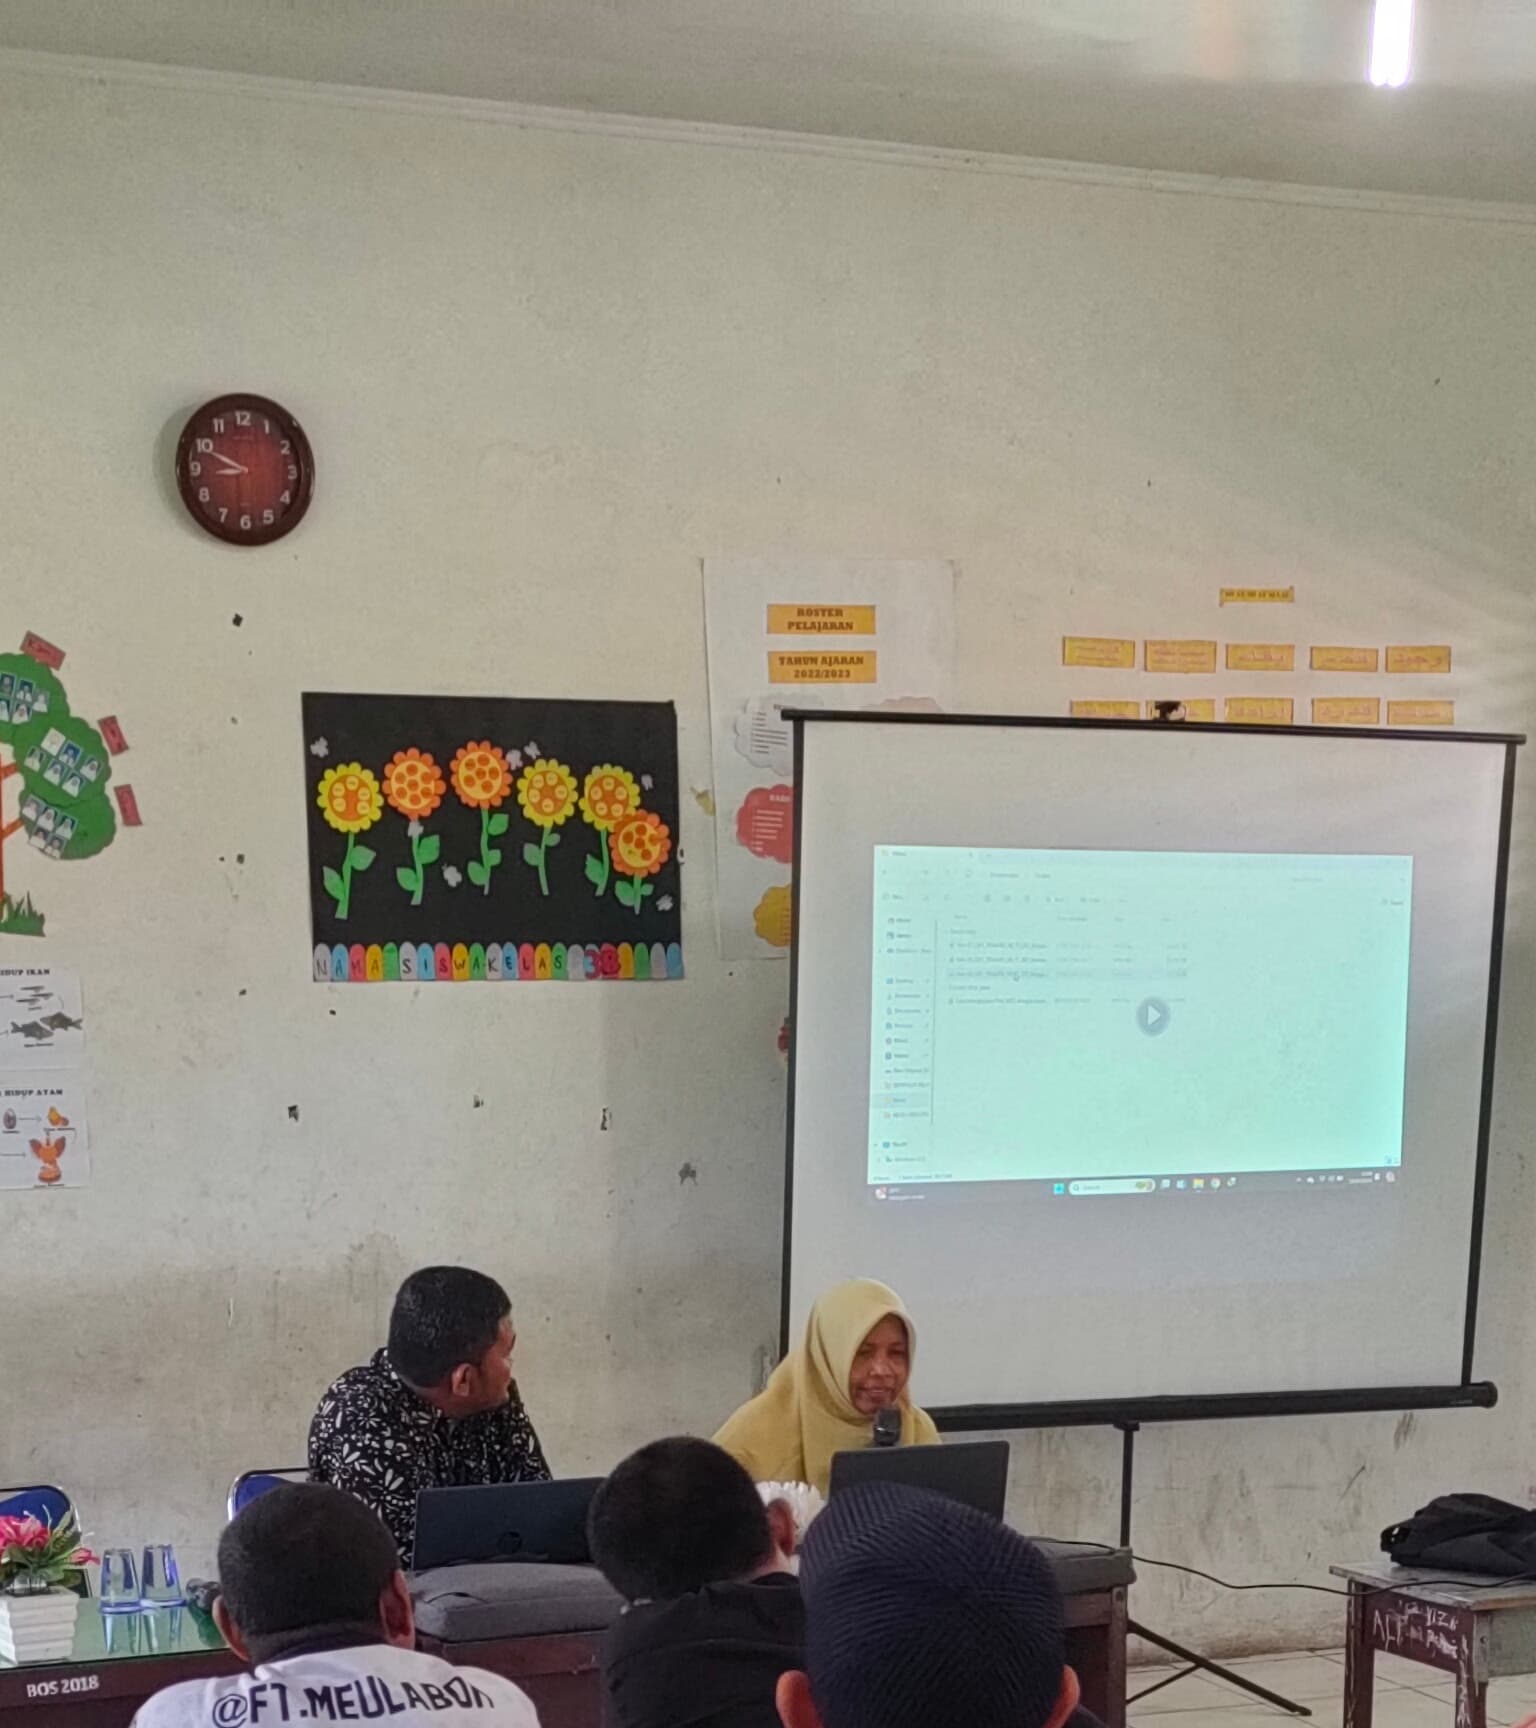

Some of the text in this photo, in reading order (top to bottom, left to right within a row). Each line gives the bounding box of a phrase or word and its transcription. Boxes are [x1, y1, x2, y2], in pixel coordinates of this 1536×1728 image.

[213, 418, 224, 433] 11
[235, 411, 251, 426] 12
[264, 419, 270, 434] 1
[196, 438, 213, 453] 10
[280, 440, 290, 455] 2
[191, 461, 201, 476] 9
[288, 465, 298, 480] 3
[198, 487, 210, 502] 8
[280, 490, 291, 504] 4
[218, 508, 228, 523] 7
[240, 515, 251, 529] 6
[263, 510, 274, 524] 5
[796, 607, 844, 617] ROSTER
[787, 621, 854, 633] PELAJARAN
[778, 656, 864, 667] TAHUN AJARAN
[794, 669, 851, 679] 2022/2023
[26, 968, 51, 976] IKAN
[316, 958, 380, 976] NAMA
[401, 957, 481, 975] SISWA
[486, 955, 563, 973] KELAS
[4, 1088, 35, 1097] HIDUP
[36, 1088, 64, 1097] AYAM
[26, 1674, 100, 1698] BOS 2018
